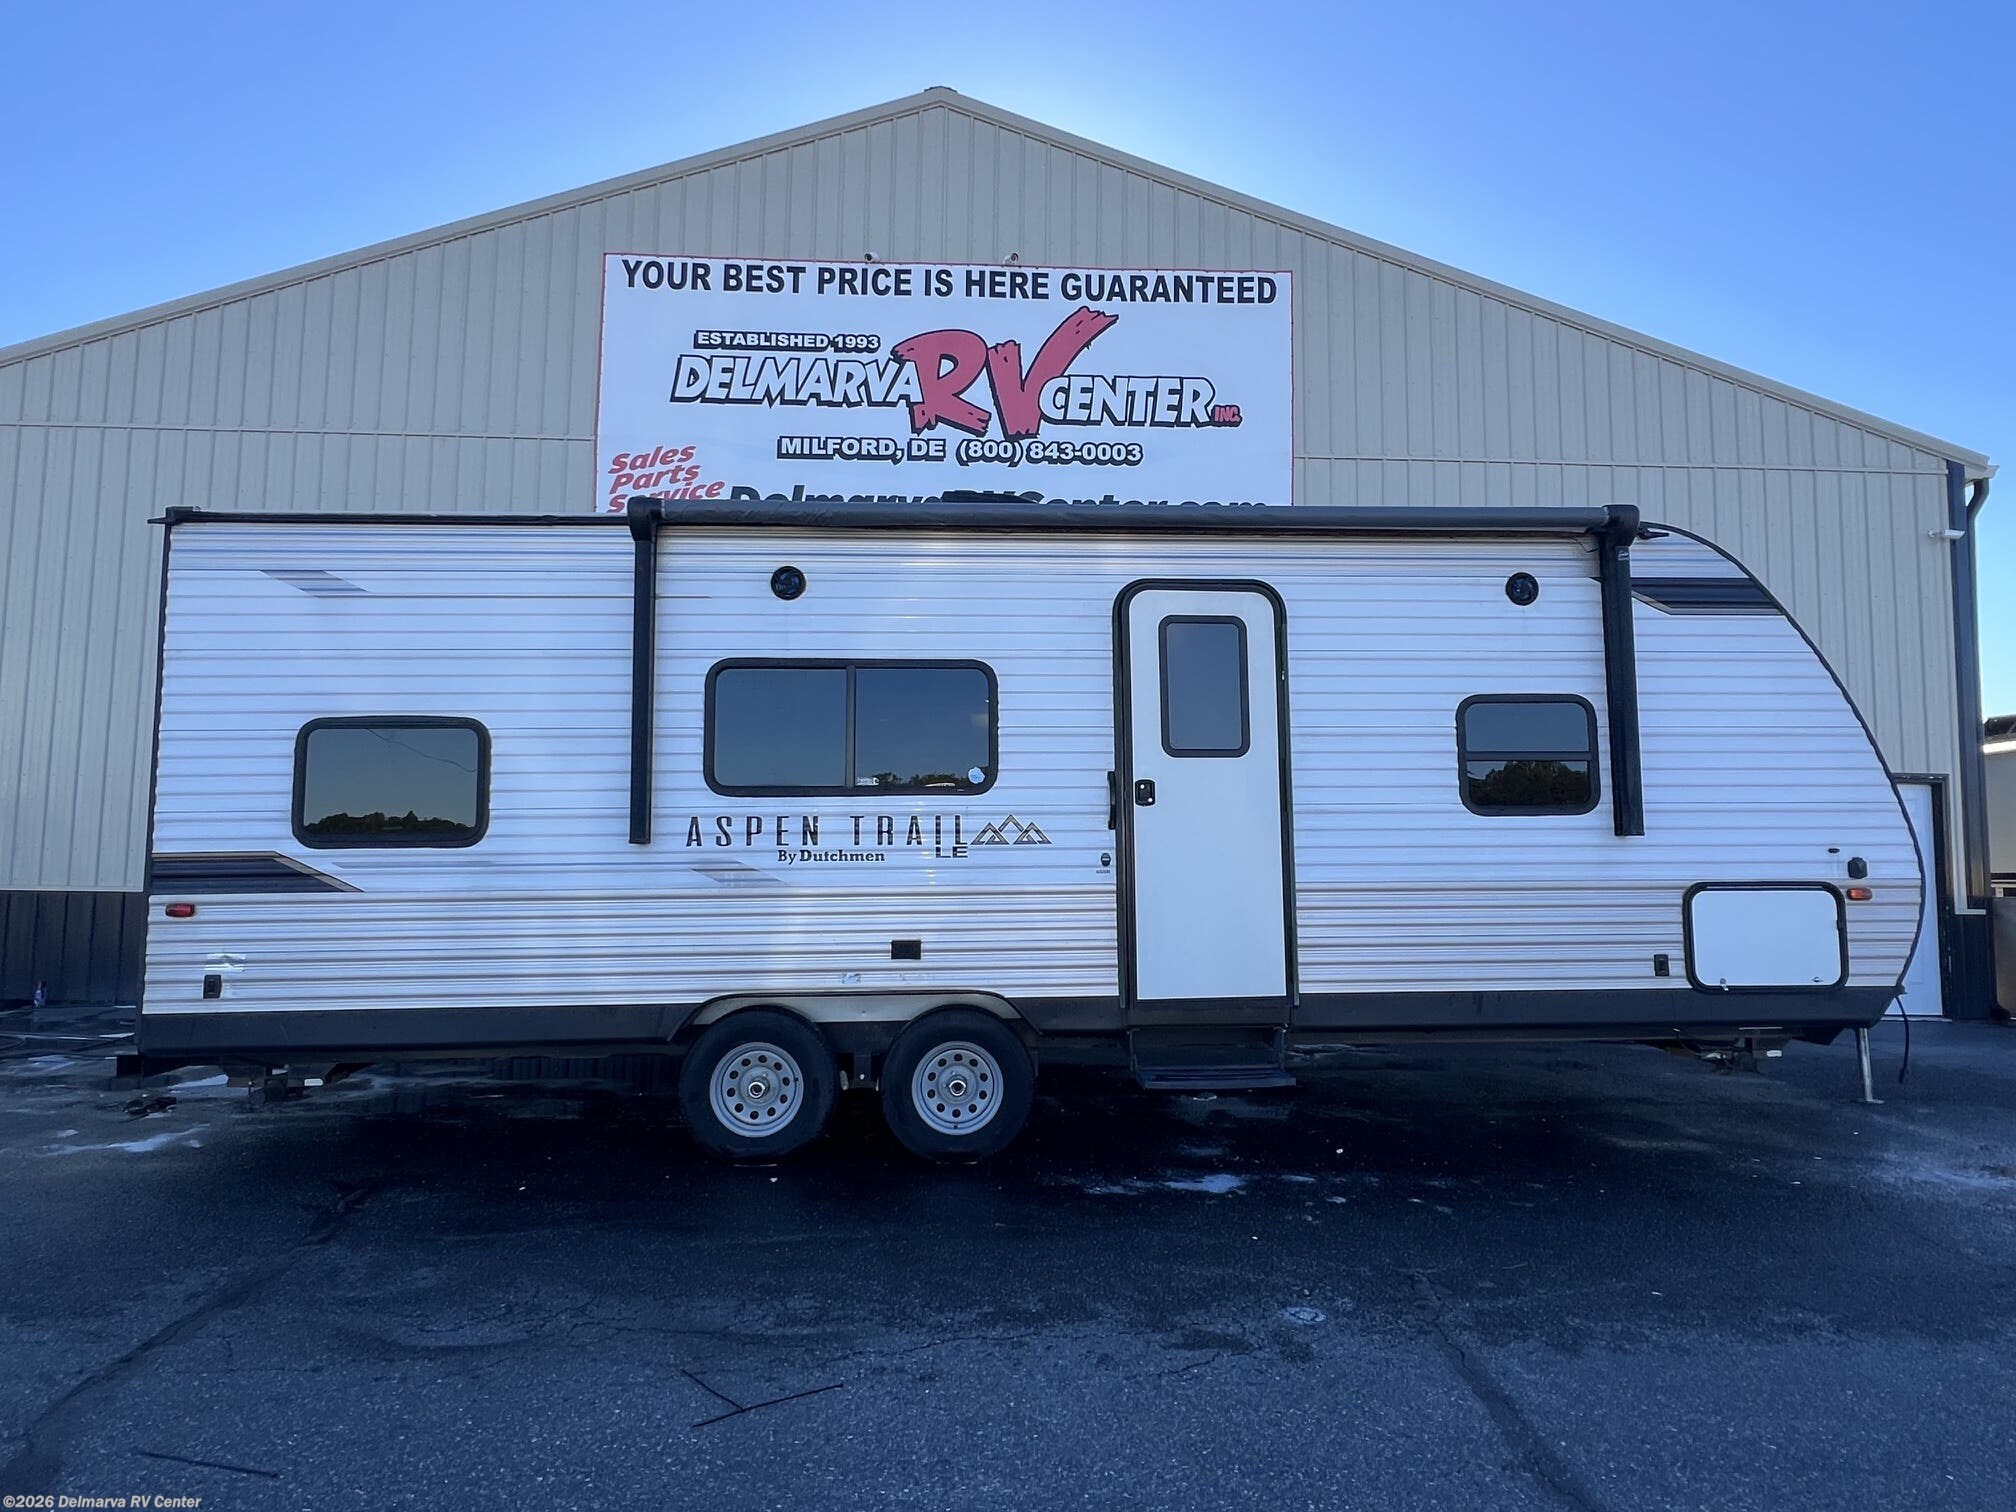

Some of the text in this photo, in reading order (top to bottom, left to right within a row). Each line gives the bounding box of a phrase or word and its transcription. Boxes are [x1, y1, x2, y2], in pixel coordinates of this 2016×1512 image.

[622, 259, 1277, 304] YOUR BEST PRICE IS HERE GUARANTEED
[694, 330, 881, 352] ESTABLISHED 1993
[670, 354, 925, 408] DELMARVA
[890, 306, 1119, 441] RV
[1039, 375, 1216, 427] CENTER
[608, 446, 697, 474] Sales
[777, 436, 1143, 467] MILFORD, DE (800) 843-0003
[609, 465, 701, 495] Parts
[686, 815, 968, 847] ASPEN TRAIL
[777, 850, 885, 865] By Dutchmen
[935, 846, 968, 858] LE
